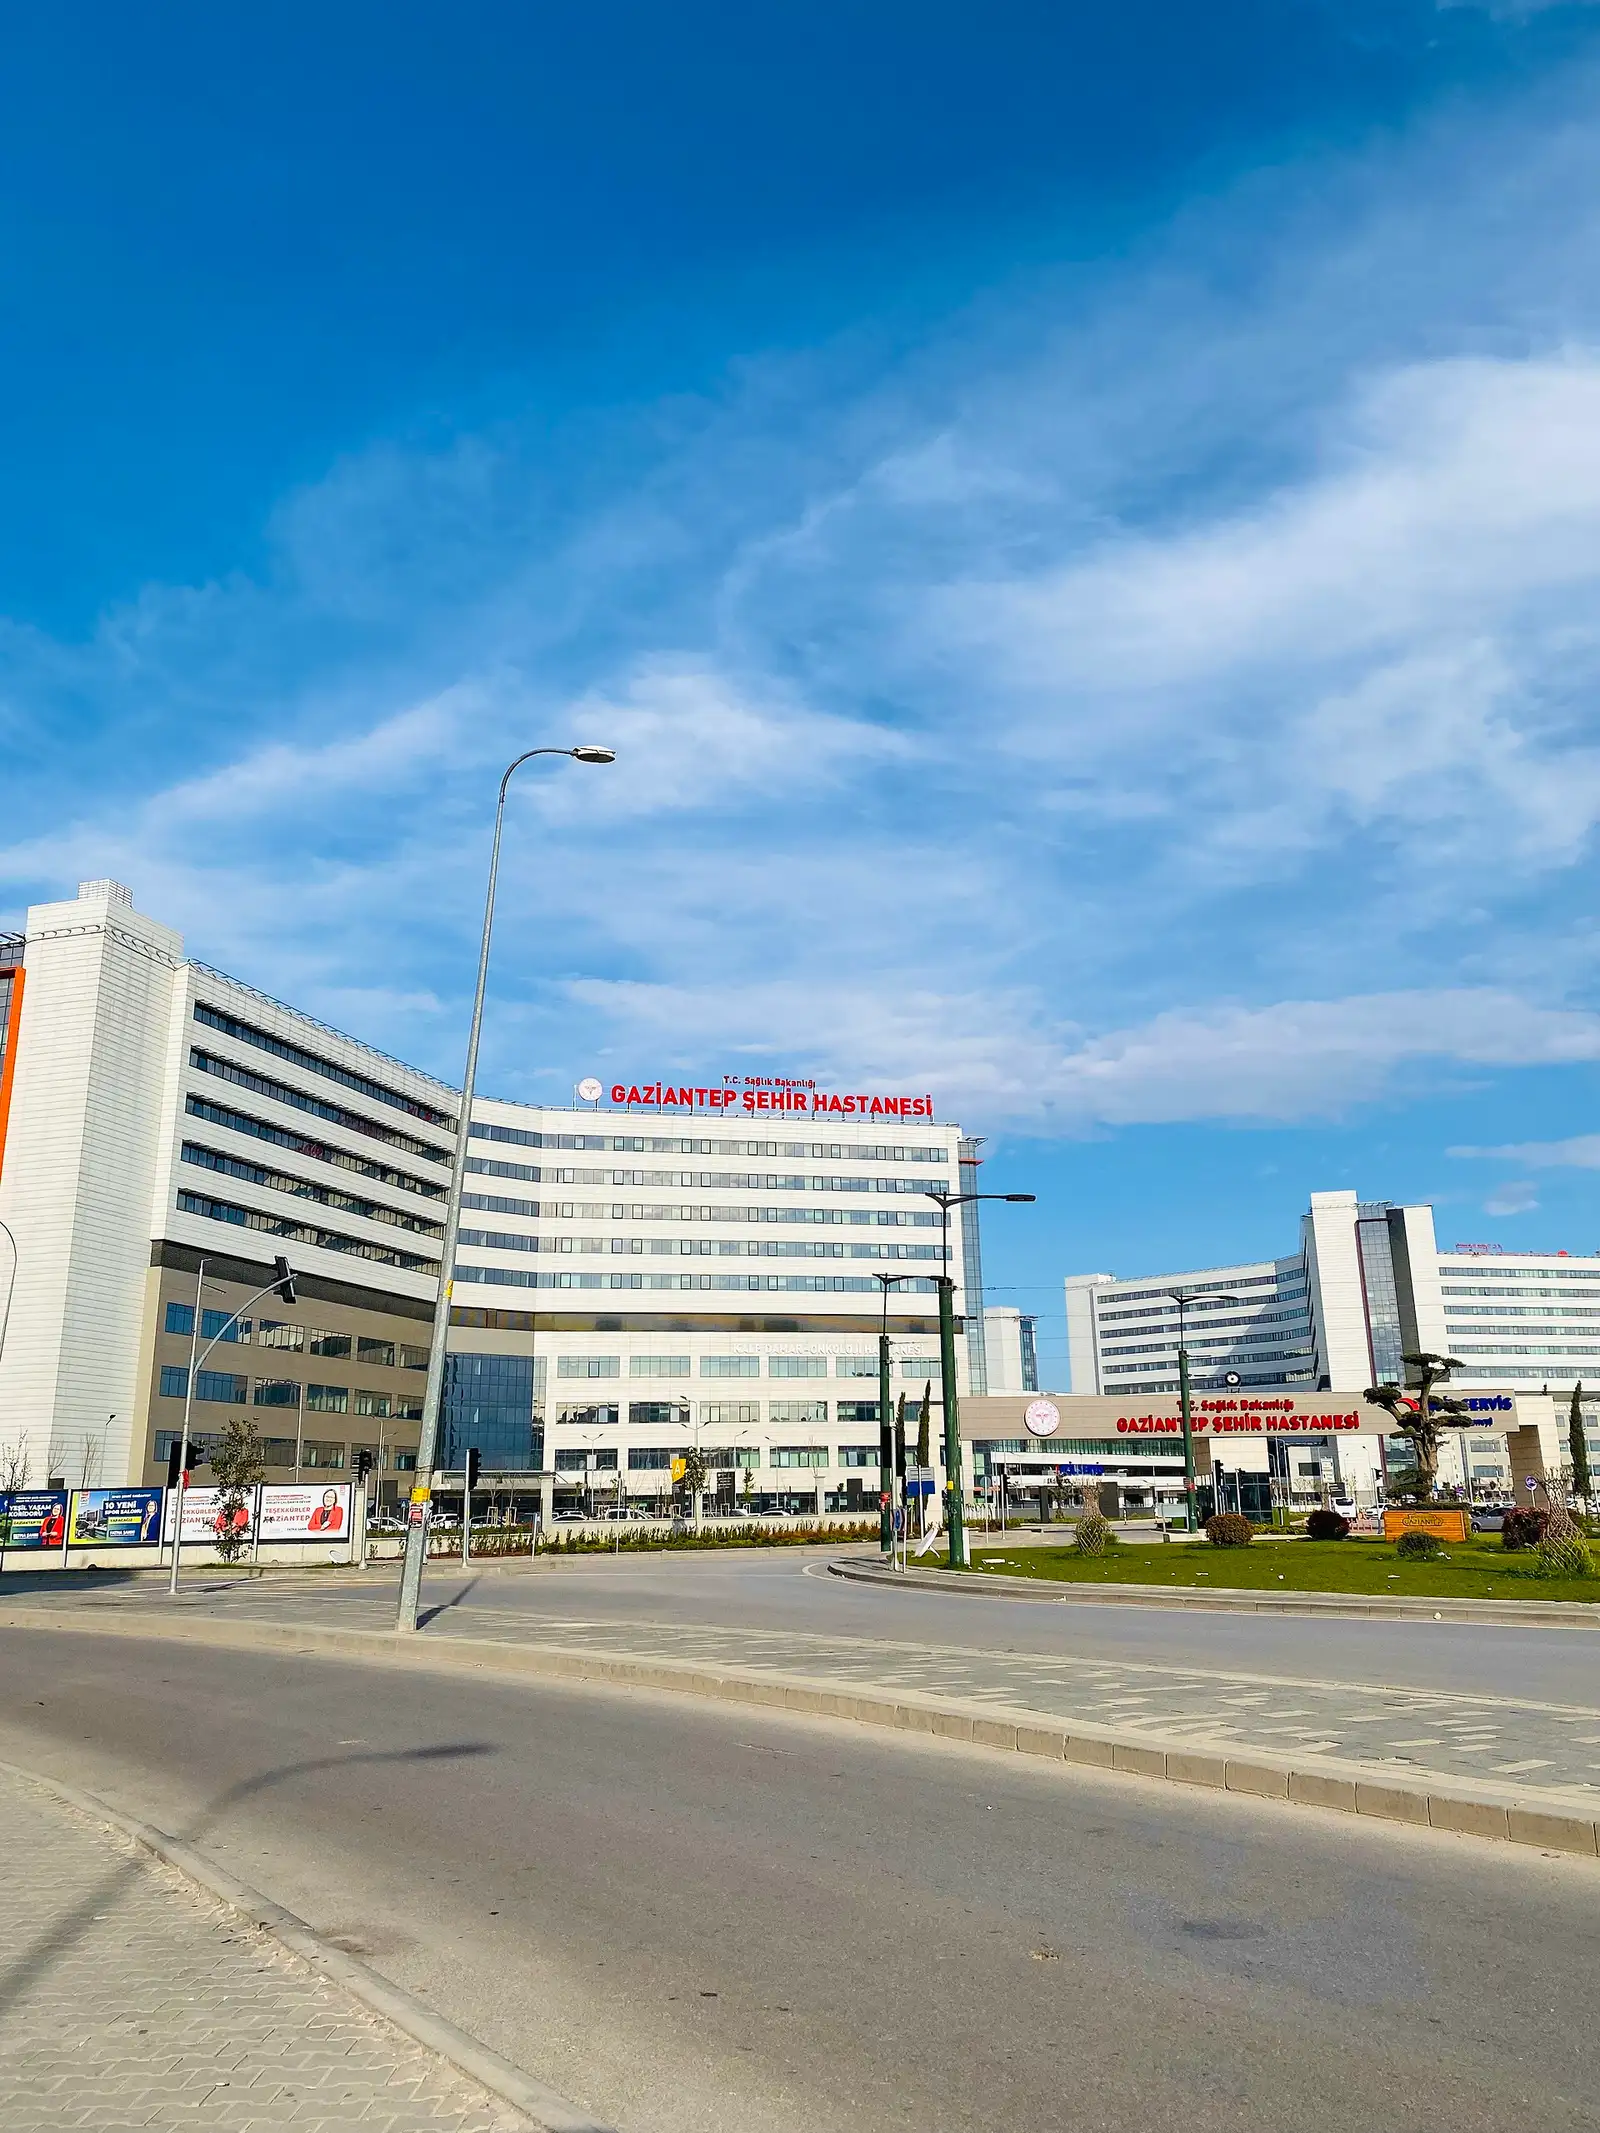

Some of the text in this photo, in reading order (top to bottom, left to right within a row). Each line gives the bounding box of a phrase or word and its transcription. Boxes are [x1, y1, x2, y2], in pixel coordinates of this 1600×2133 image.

[724, 1076, 816, 1089] T.C. Sağlık Bakanlığı
[611, 1081, 933, 1116] GAZİANTEP ŞEHİR HASTANESİ
[1201, 1399, 1238, 1413] Sağlık
[1240, 1399, 1294, 1412] Bakanlığı
[1212, 1412, 1262, 1433] ŞEHİR
[1266, 1410, 1359, 1431] HASTANESİ
[674, 1462, 681, 1475] A
[116, 1500, 137, 1508] YENİ
[265, 1506, 311, 1514] TEŞEKKÜRLER
